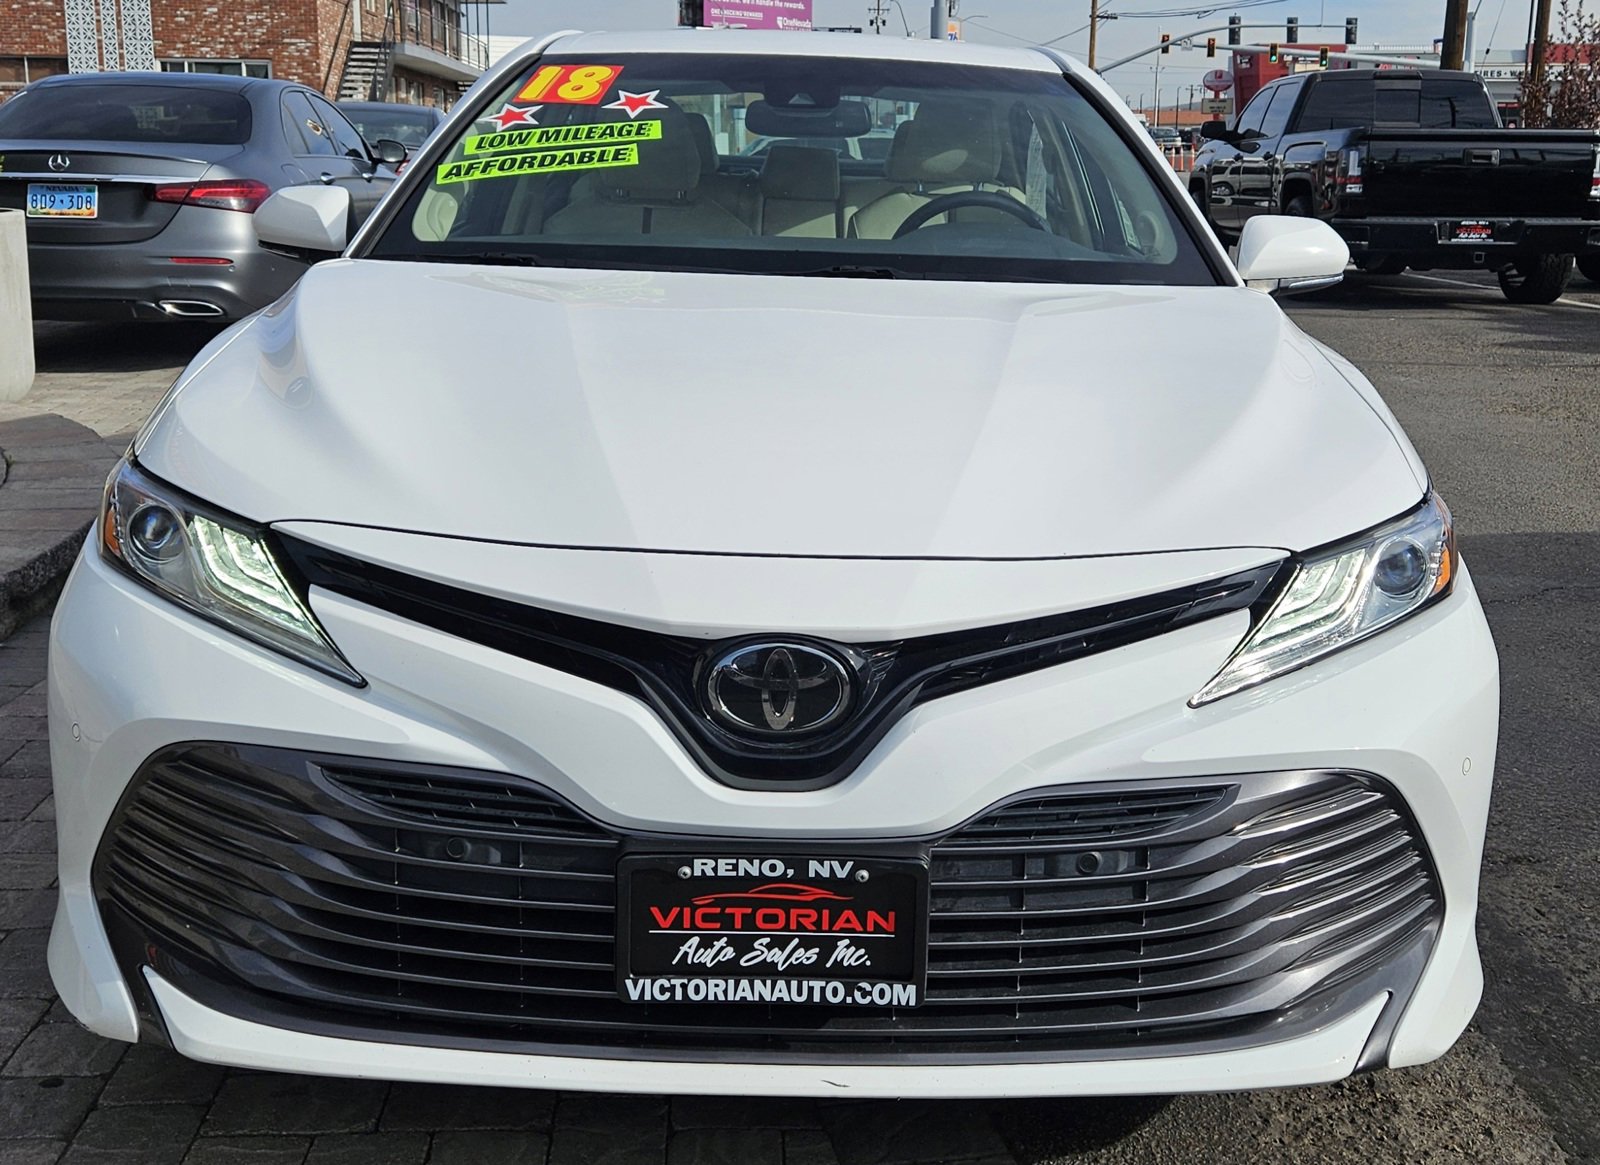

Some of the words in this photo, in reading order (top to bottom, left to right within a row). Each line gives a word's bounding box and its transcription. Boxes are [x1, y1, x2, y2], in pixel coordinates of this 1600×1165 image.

[783, 17, 812, 27] OneNevada
[519, 65, 615, 101] 18
[474, 131, 534, 150] LOW
[536, 122, 652, 144] MILEAGE
[442, 147, 634, 180] AFFORDABLE
[693, 859, 794, 879] RENO,
[809, 860, 855, 879] NV
[649, 906, 896, 932] VICTORIAN
[672, 936, 736, 968] Auto
[740, 937, 820, 971] Sales
[825, 938, 871, 968] Inc.
[624, 978, 917, 1007] VICTORIANAUTO.COM
